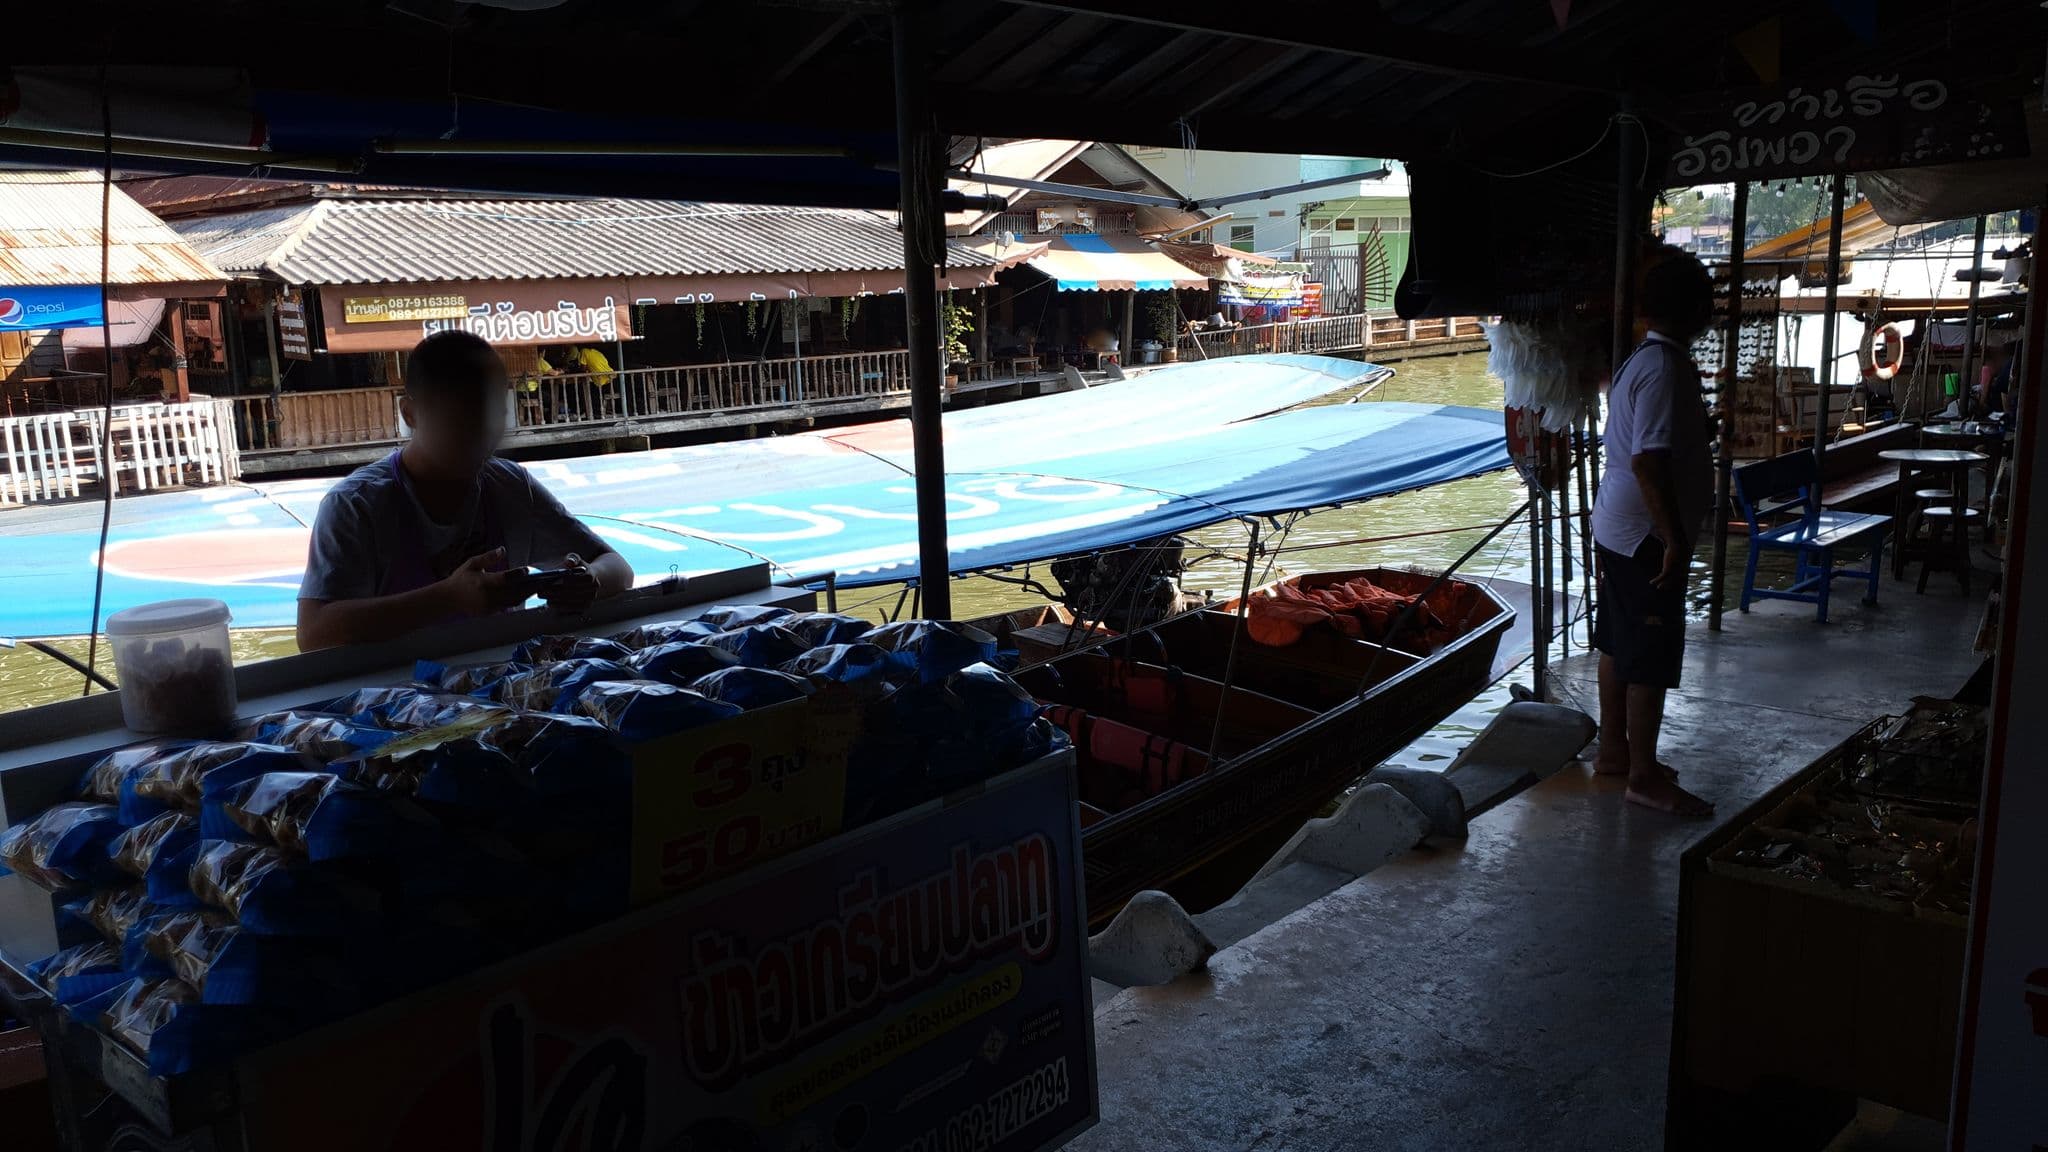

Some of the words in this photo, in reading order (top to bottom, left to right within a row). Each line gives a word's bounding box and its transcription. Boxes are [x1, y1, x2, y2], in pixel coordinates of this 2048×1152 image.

[26, 300, 66, 315] pepsi
[388, 296, 465, 309] 087-9163388
[691, 741, 752, 809] 3
[660, 815, 762, 889] 50
